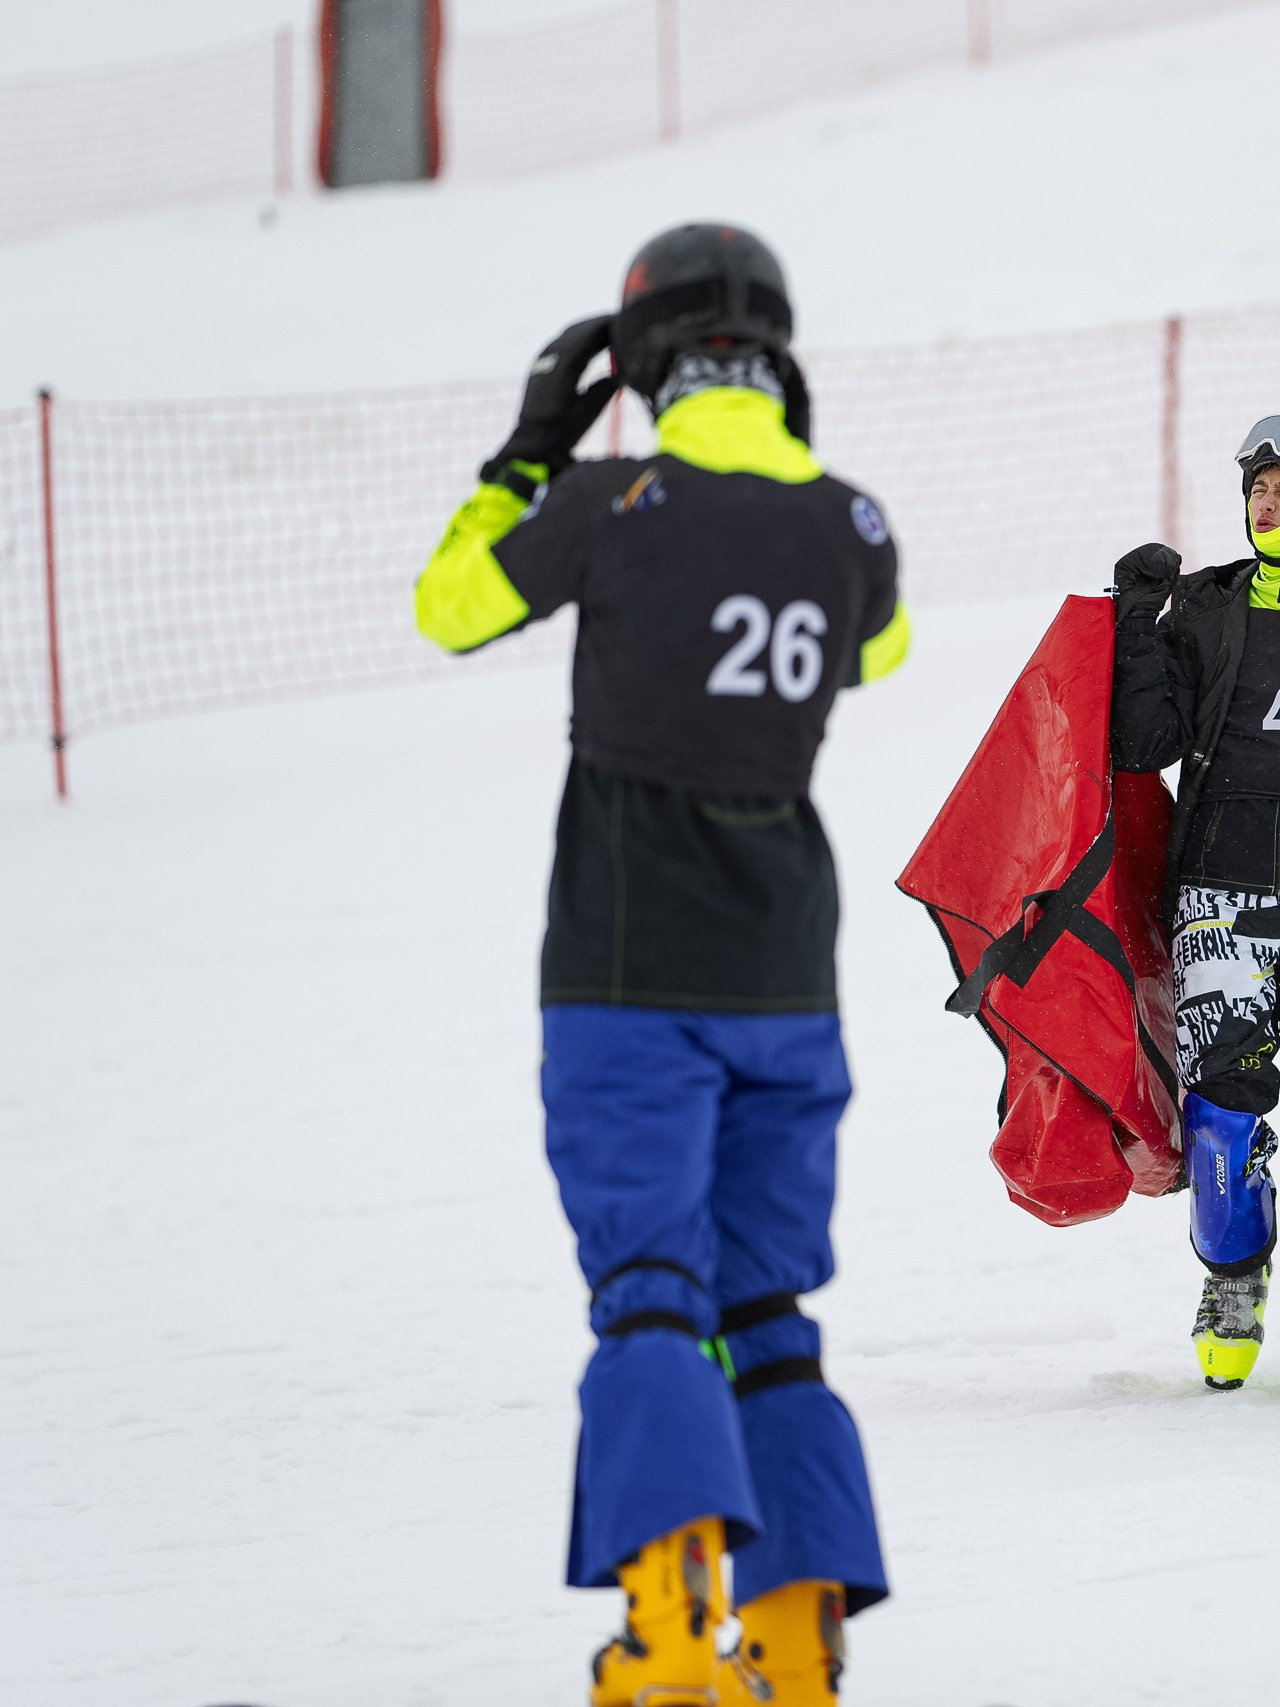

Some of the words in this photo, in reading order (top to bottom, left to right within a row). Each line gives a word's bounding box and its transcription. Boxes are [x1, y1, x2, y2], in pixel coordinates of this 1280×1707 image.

[706, 594, 828, 703] 26
[1184, 903, 1214, 922] RIDE
[1216, 1153, 1225, 1183] COBER
